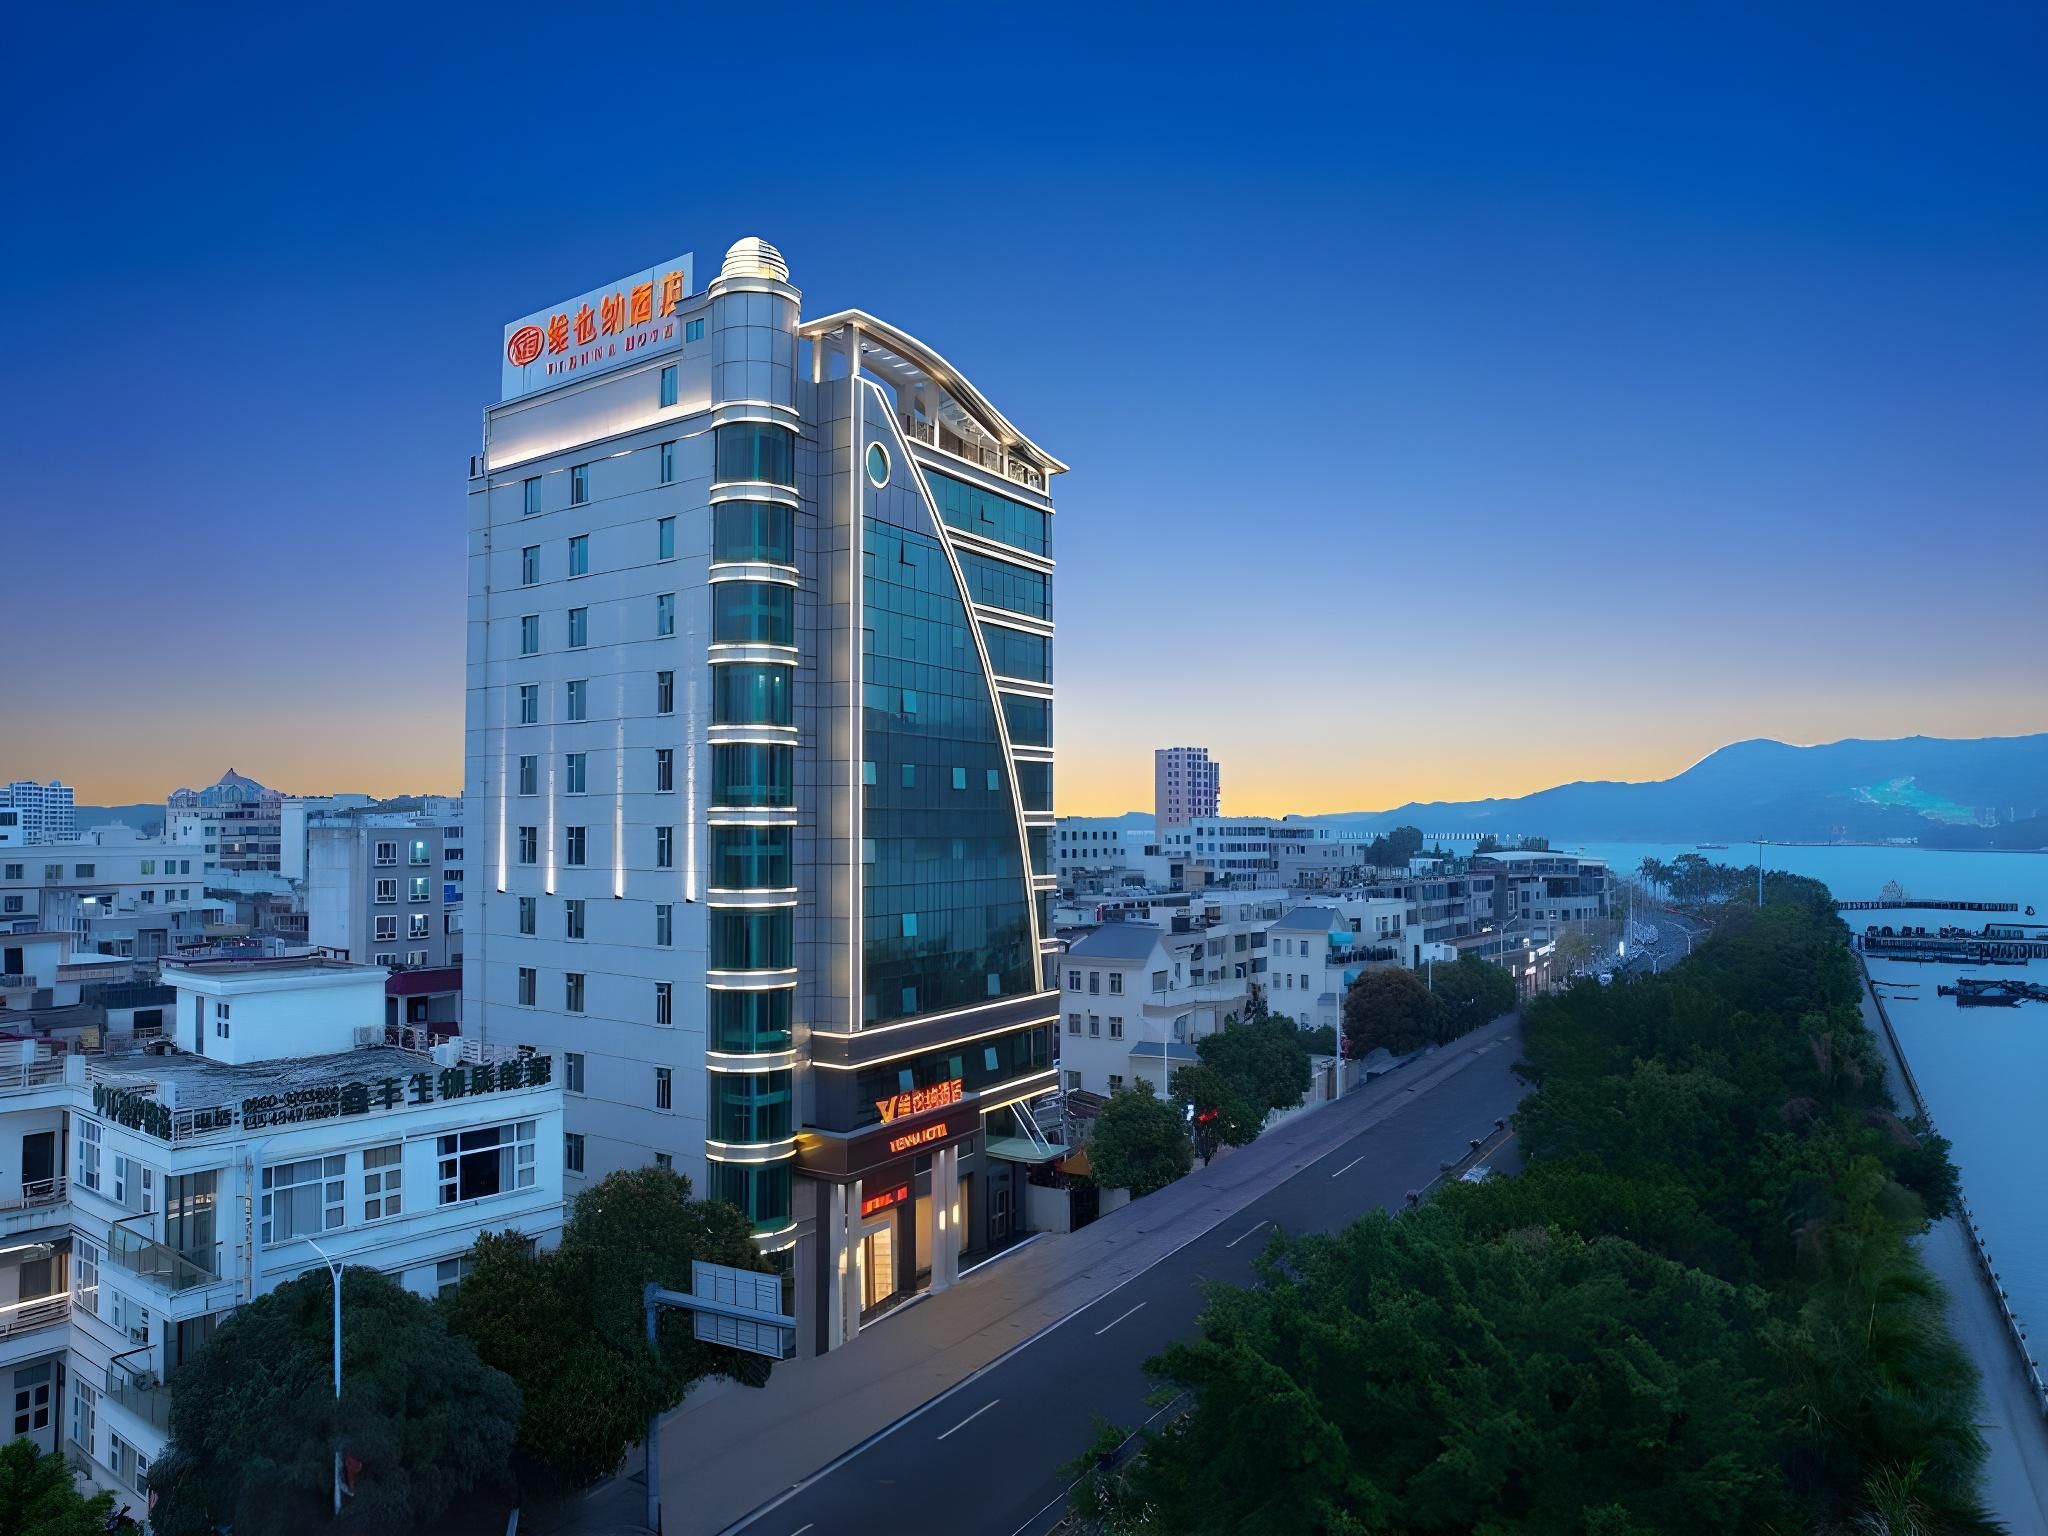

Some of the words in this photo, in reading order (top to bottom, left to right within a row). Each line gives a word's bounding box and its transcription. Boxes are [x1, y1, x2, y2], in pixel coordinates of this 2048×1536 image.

[547, 270, 684, 354] 维也纳酒店
